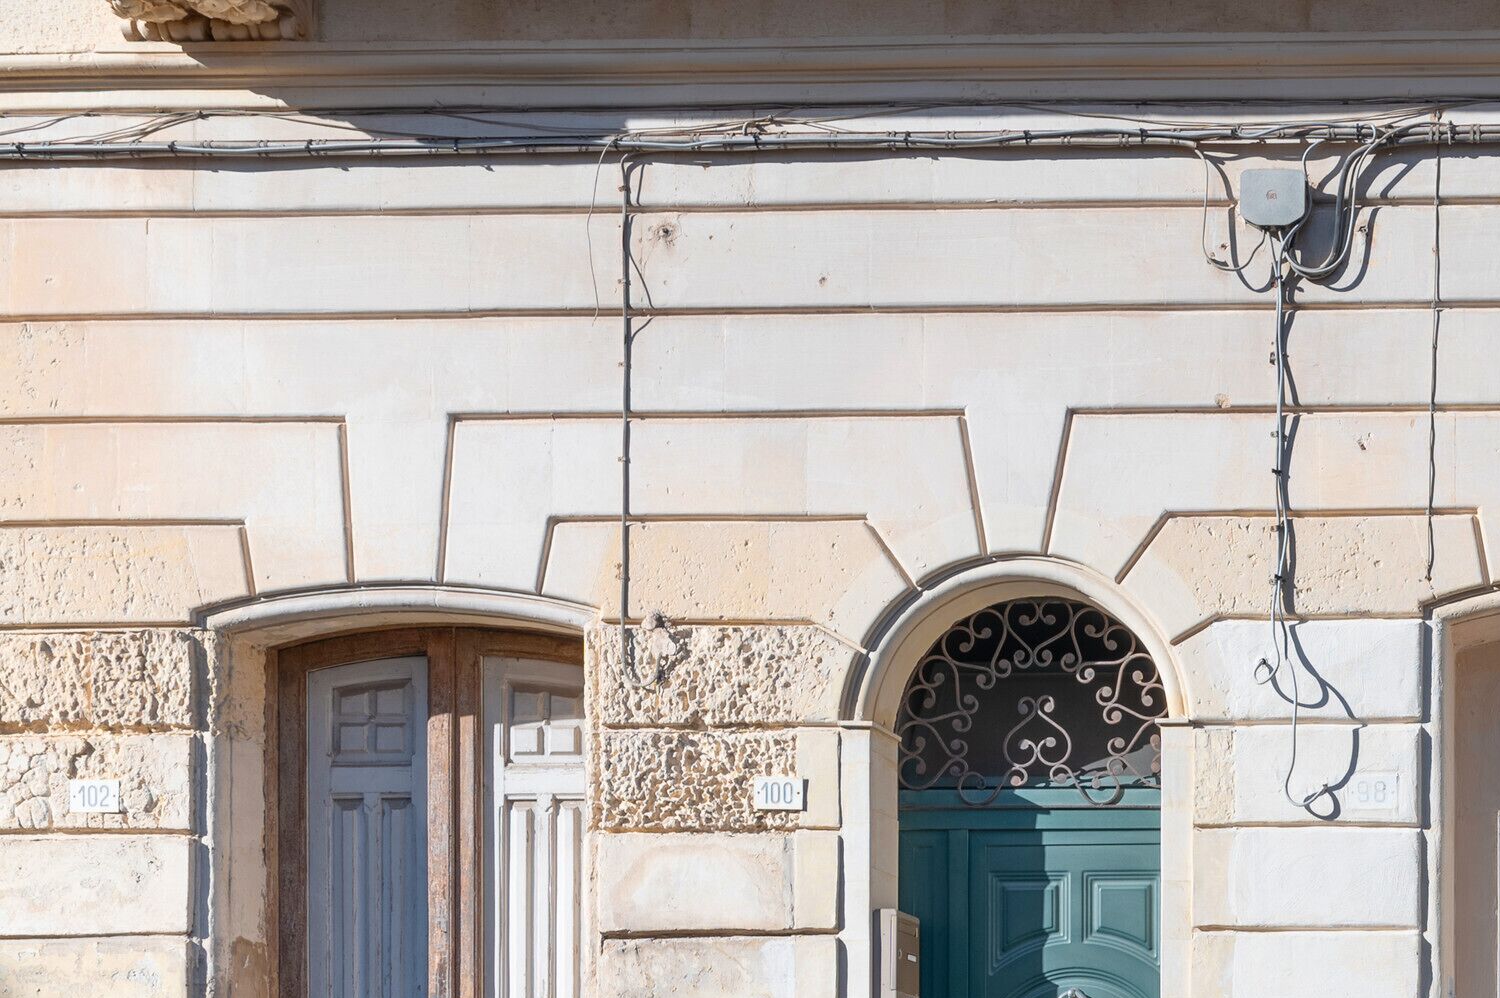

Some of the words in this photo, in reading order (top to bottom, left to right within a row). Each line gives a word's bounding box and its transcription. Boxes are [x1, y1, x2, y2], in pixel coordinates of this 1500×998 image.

[78, 784, 110, 807] 102
[761, 781, 793, 804] 100
[1357, 780, 1386, 802] 98
